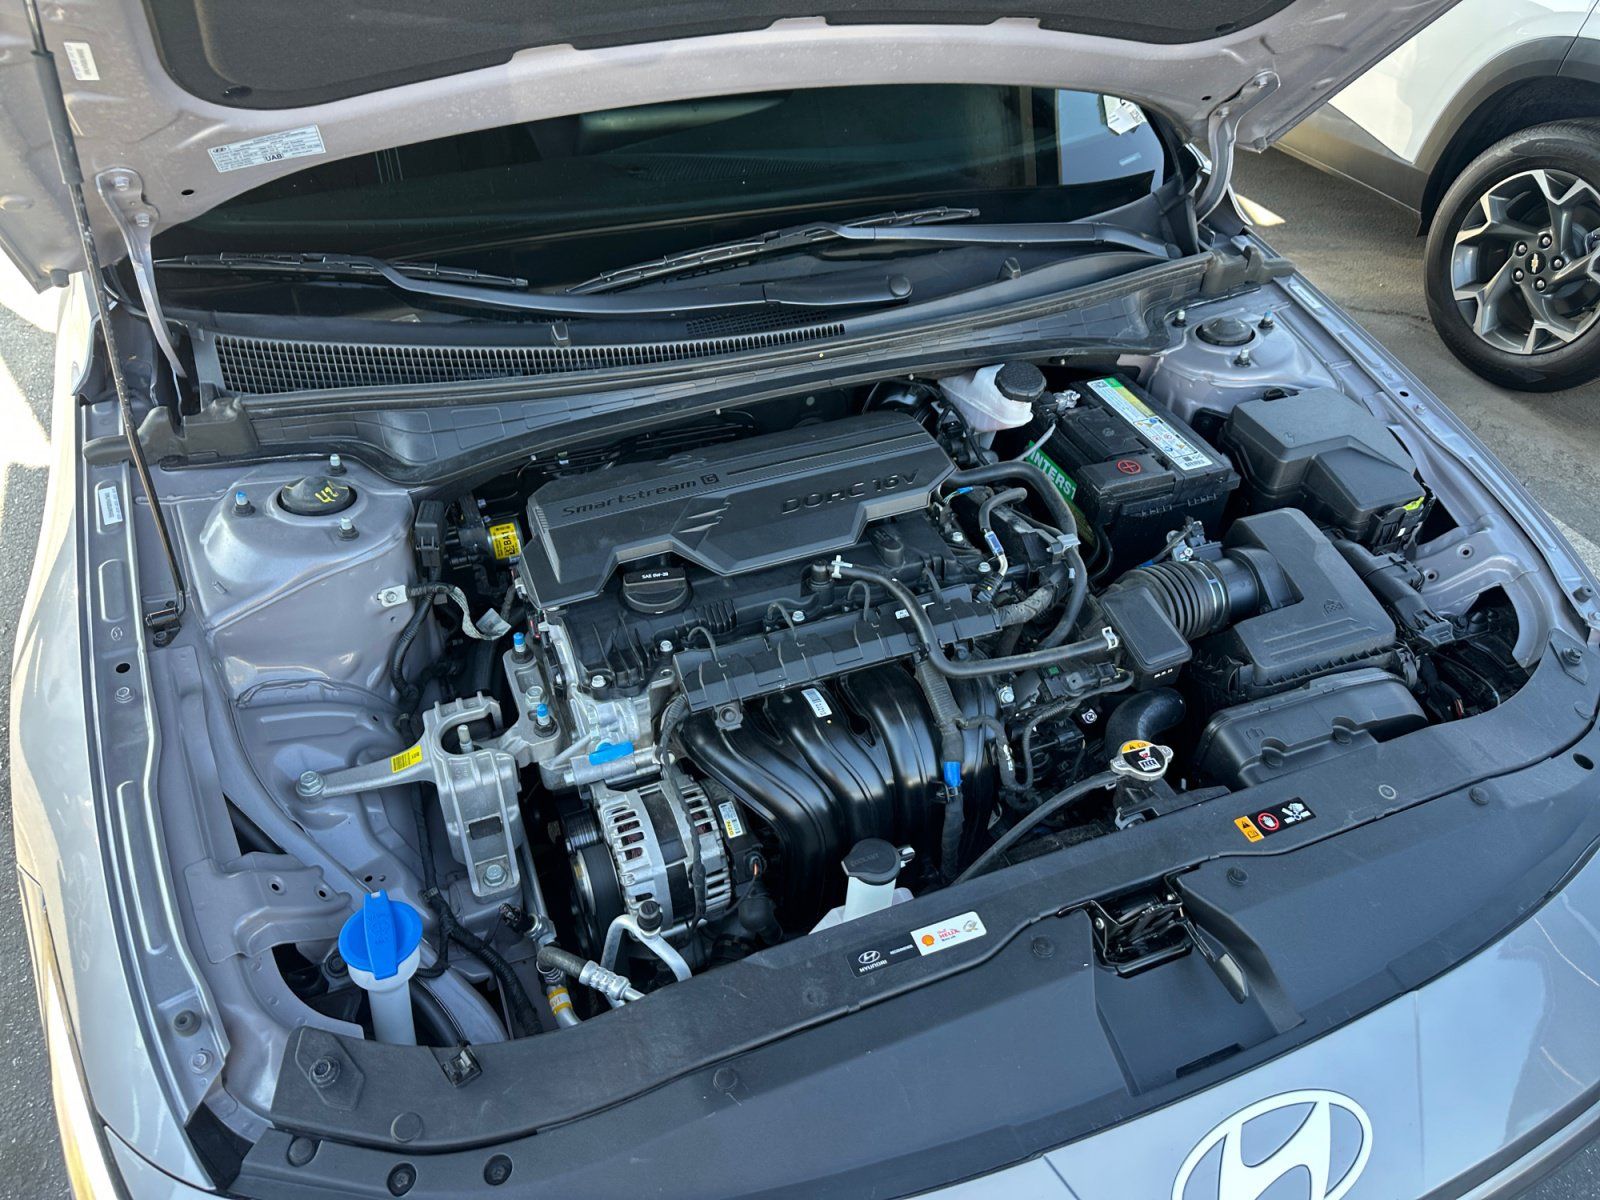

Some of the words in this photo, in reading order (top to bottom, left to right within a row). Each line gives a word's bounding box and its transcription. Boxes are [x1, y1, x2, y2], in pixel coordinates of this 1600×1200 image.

[562, 480, 697, 515] Smartstream
[781, 482, 865, 515] DOHC
[872, 468, 919, 493] 16V
[859, 960, 888, 972] HYUNDAI
